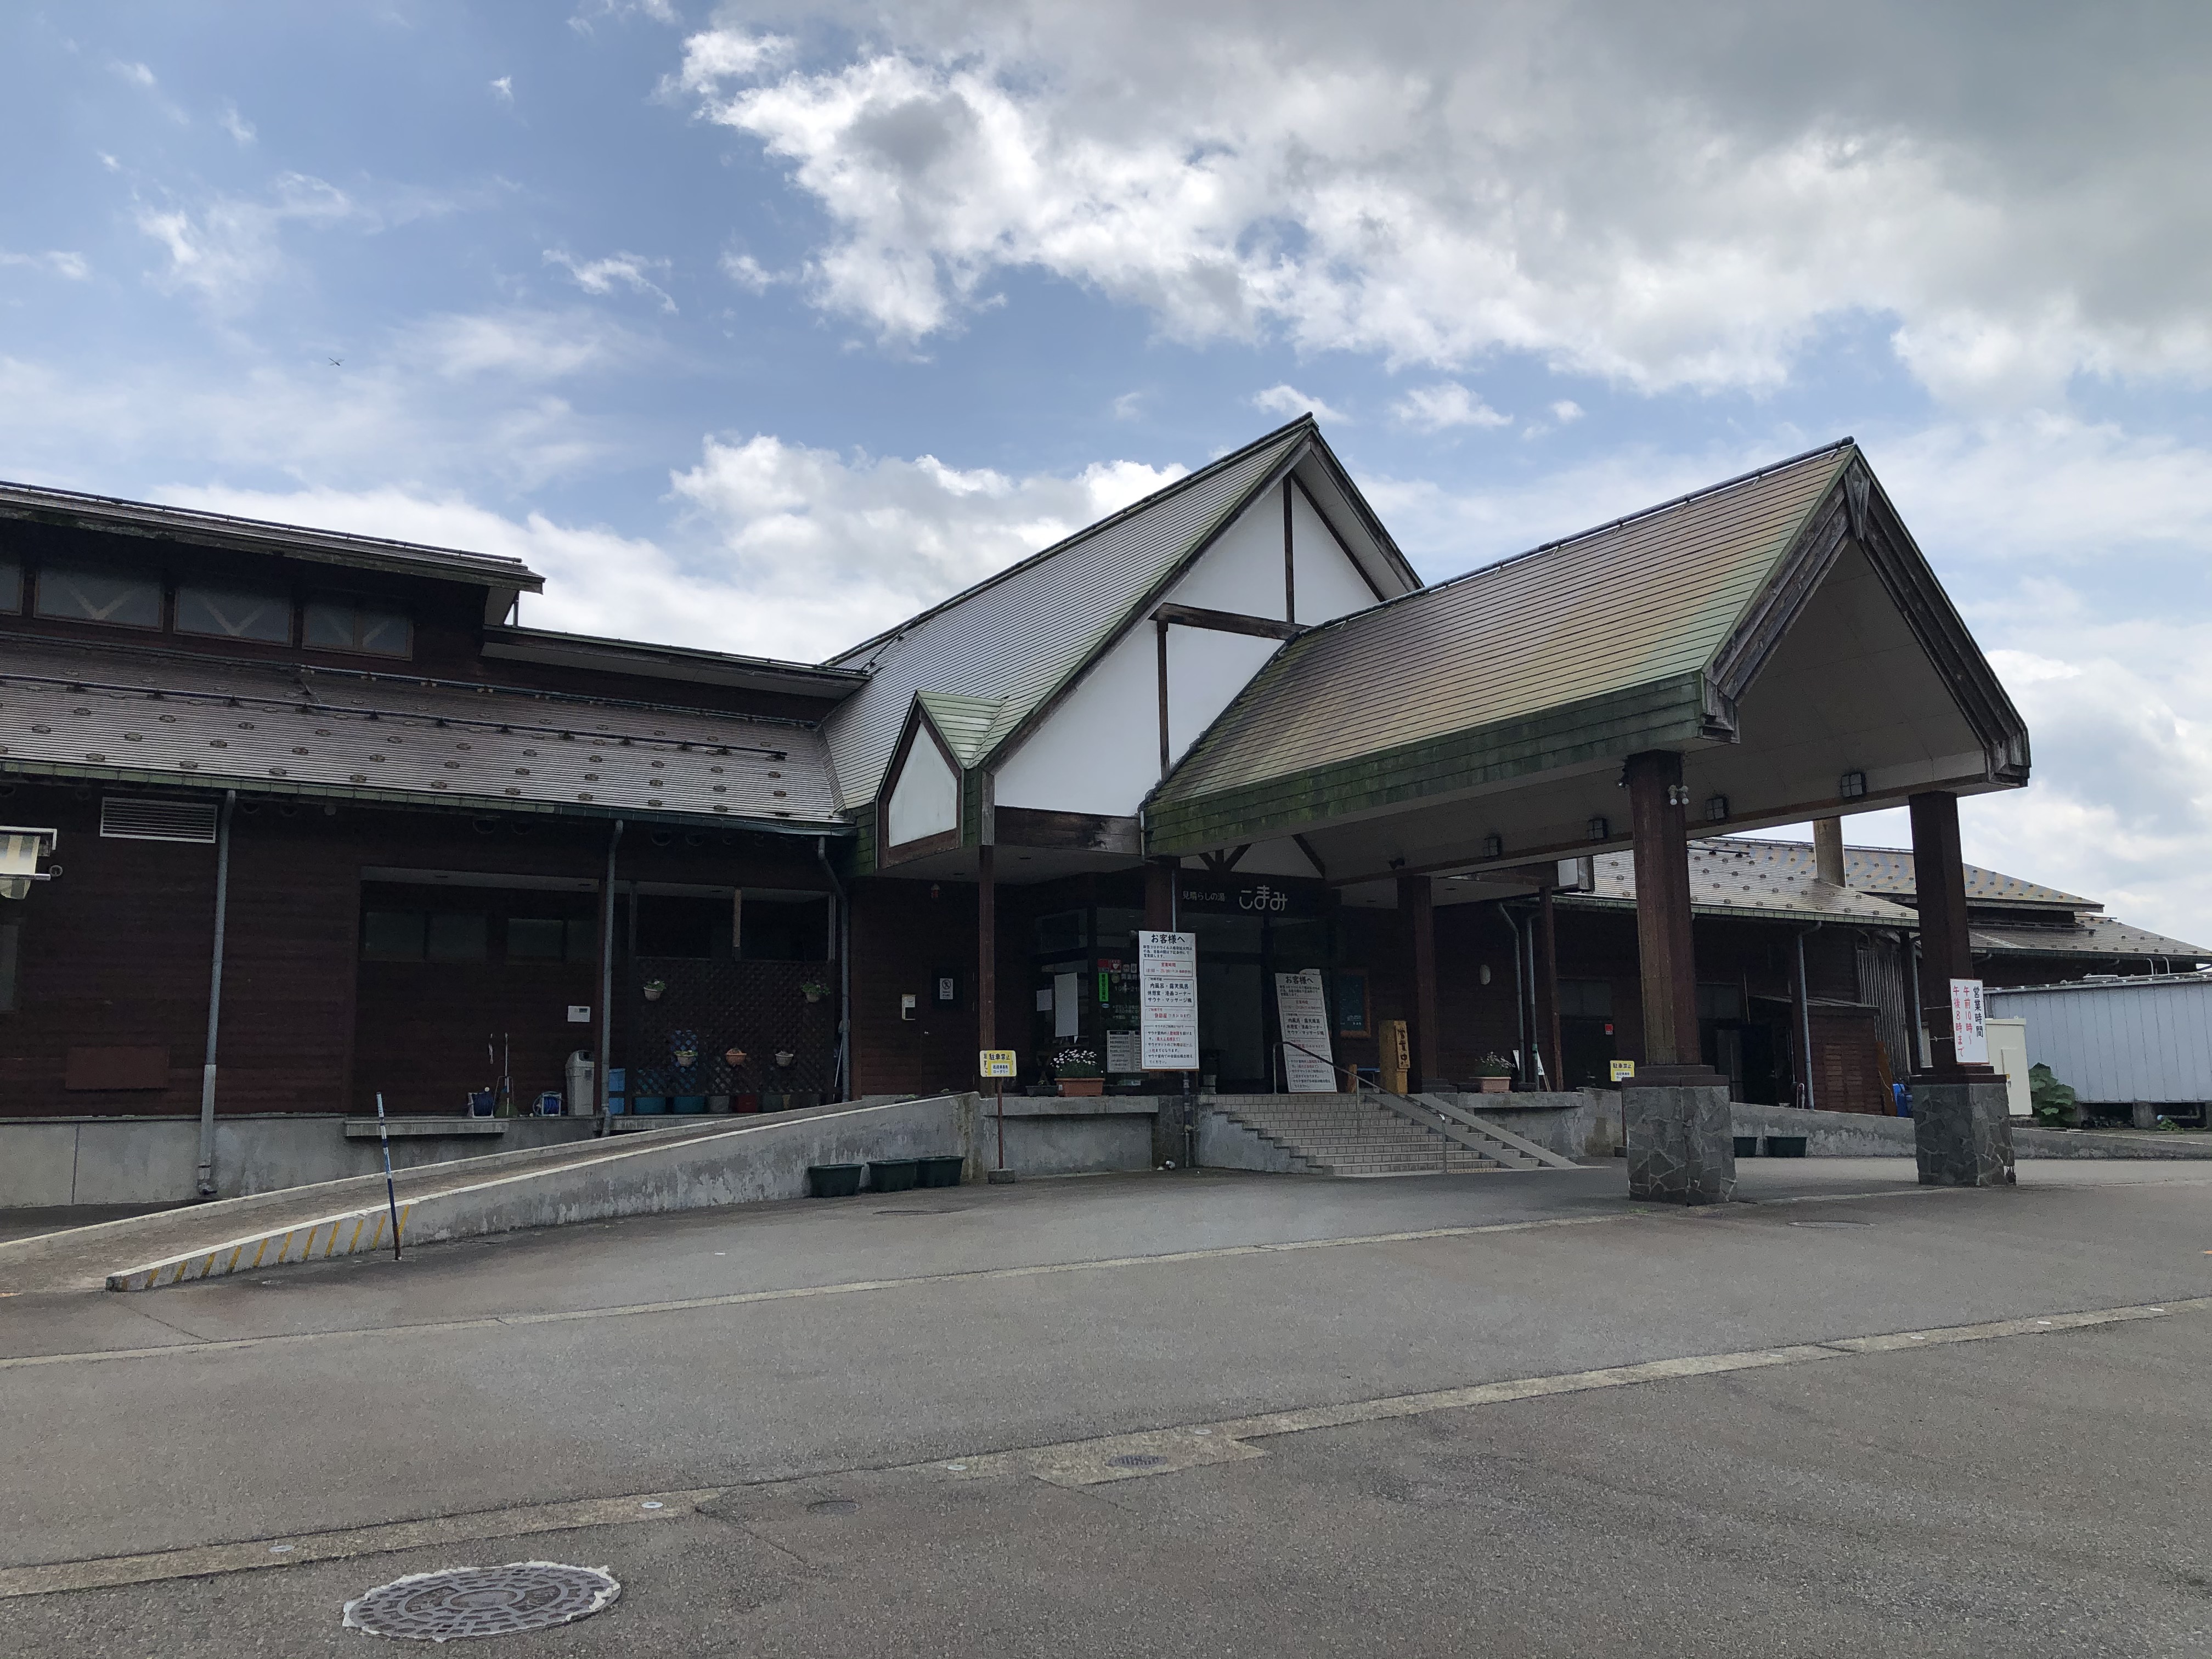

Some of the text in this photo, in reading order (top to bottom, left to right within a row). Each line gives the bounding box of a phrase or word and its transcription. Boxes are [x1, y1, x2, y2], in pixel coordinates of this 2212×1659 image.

[1183, 891, 1225, 902] 見晴らしの湯
[1239, 885, 1288, 911] こまみ
[1151, 934, 1185, 944] お客様へ
[1285, 975, 1314, 984] お客様へ
[1953, 985, 1965, 1057] 午後8時まで
[1963, 985, 1973, 1045] 午前10時～
[1973, 986, 1984, 1038] 営業時間
